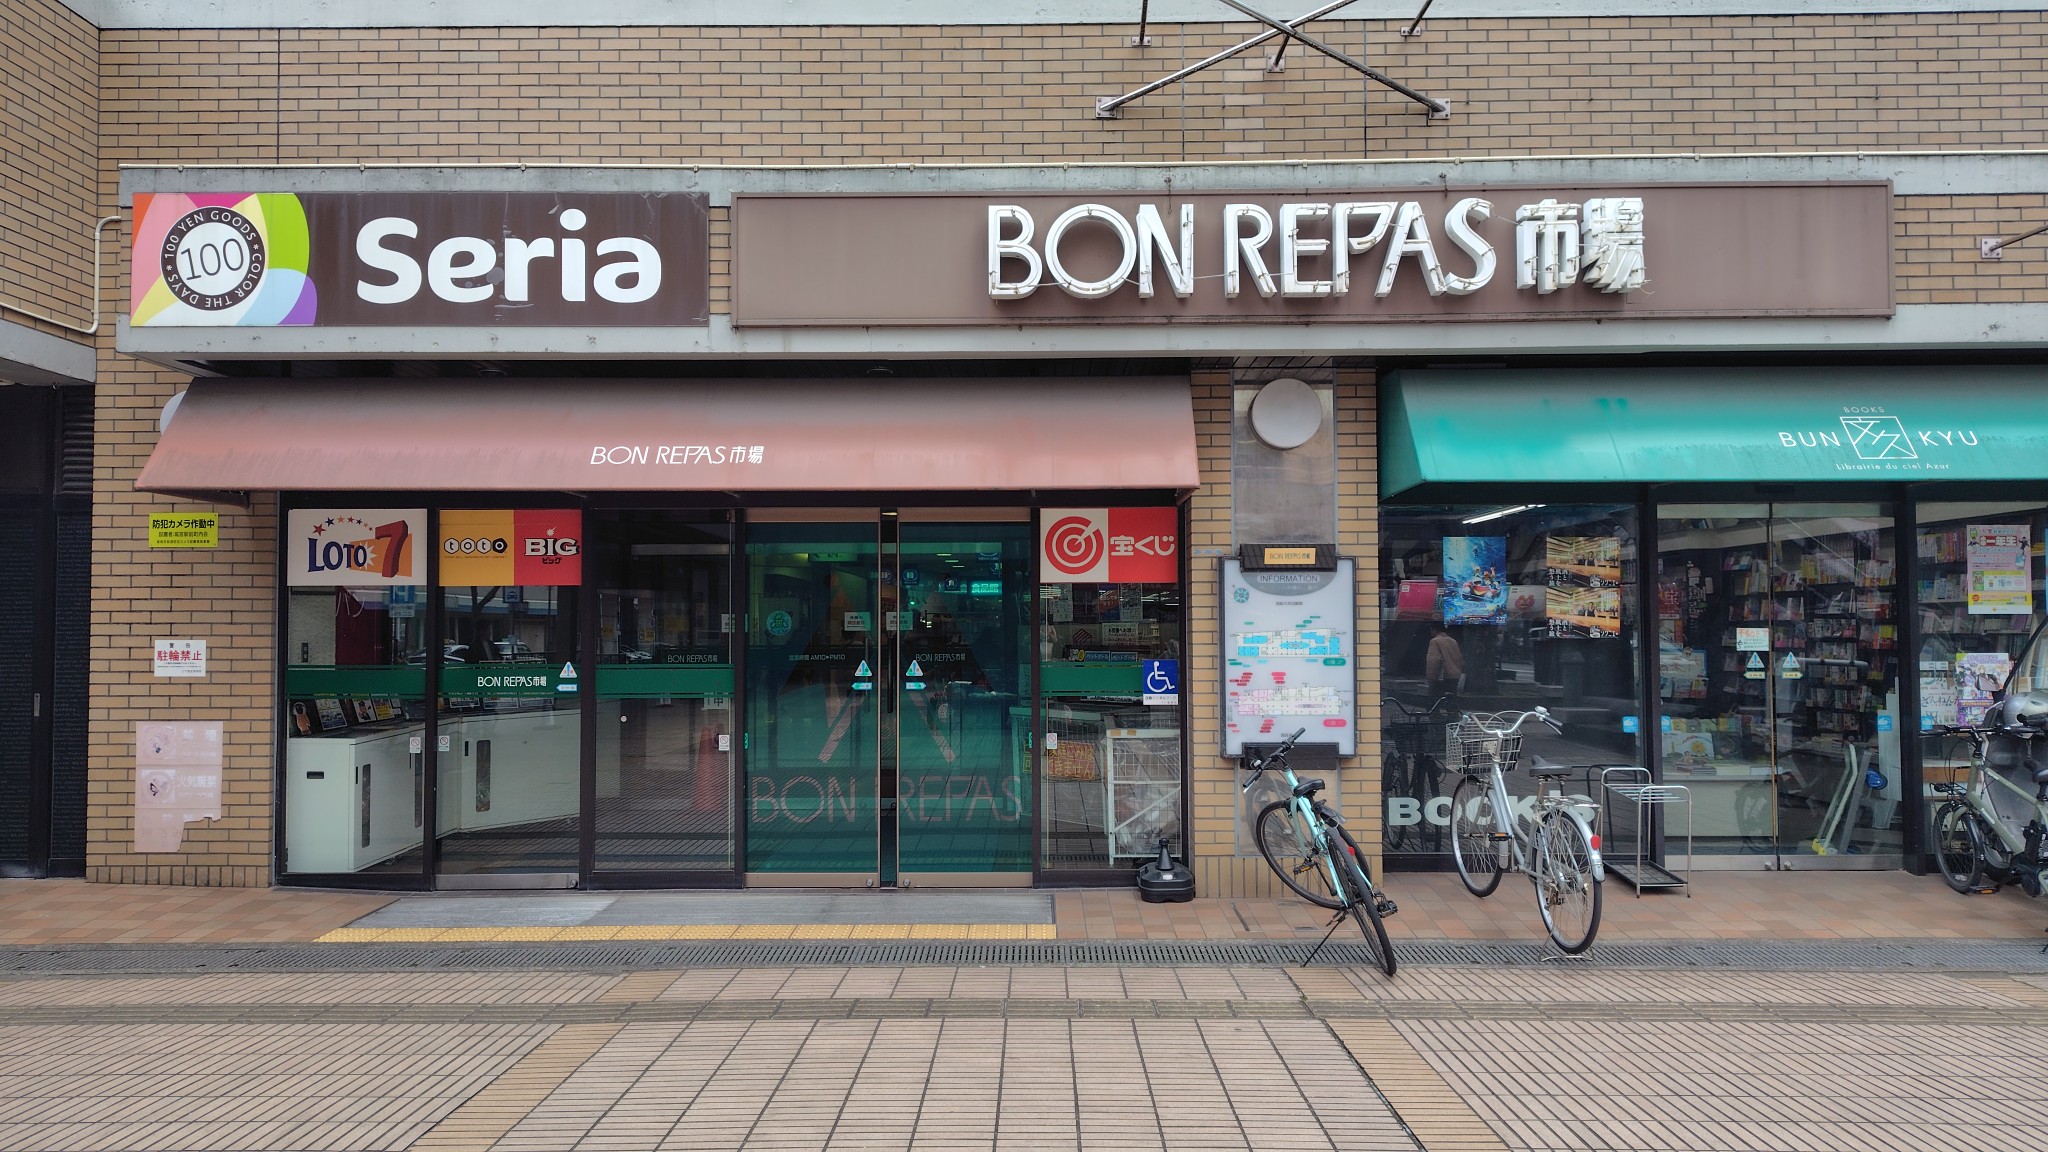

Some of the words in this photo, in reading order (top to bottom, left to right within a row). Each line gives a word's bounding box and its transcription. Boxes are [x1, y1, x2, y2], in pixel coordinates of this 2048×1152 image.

[164, 235, 179, 259] 100
[177, 212, 204, 232] YEN
[210, 210, 256, 241] GOODS
[355, 208, 662, 304] Seria
[987, 203, 1194, 300] BON
[1223, 197, 1497, 300] REPAS
[1515, 197, 1649, 296] 市場
[180, 238, 244, 281] 100
[234, 253, 262, 298] COLOR
[167, 273, 200, 305] DAYS
[204, 295, 232, 308] THE
[1843, 406, 1885, 414] BOOKS
[1778, 431, 1841, 447] BUN
[1918, 430, 1978, 446] KYU
[590, 446, 649, 464] BON
[655, 446, 726, 464] REPAS
[729, 445, 765, 464] 市場
[152, 519, 215, 529] 防犯カメラ作動中
[307, 537, 368, 573] LOTO
[375, 520, 409, 578] 7
[444, 537, 508, 554] toto
[524, 537, 580, 557] BIG
[1110, 535, 1176, 556] 宝くじ
[971, 583, 999, 593] 食品館
[1260, 575, 1318, 583] INFORMATION
[157, 650, 203, 661] 駐輪禁止
[478, 676, 500, 687] BON
[504, 676, 532, 687] REPAS
[533, 676, 546, 686] 市場
[752, 776, 856, 823] BON
[876, 776, 1022, 822] REPAS
